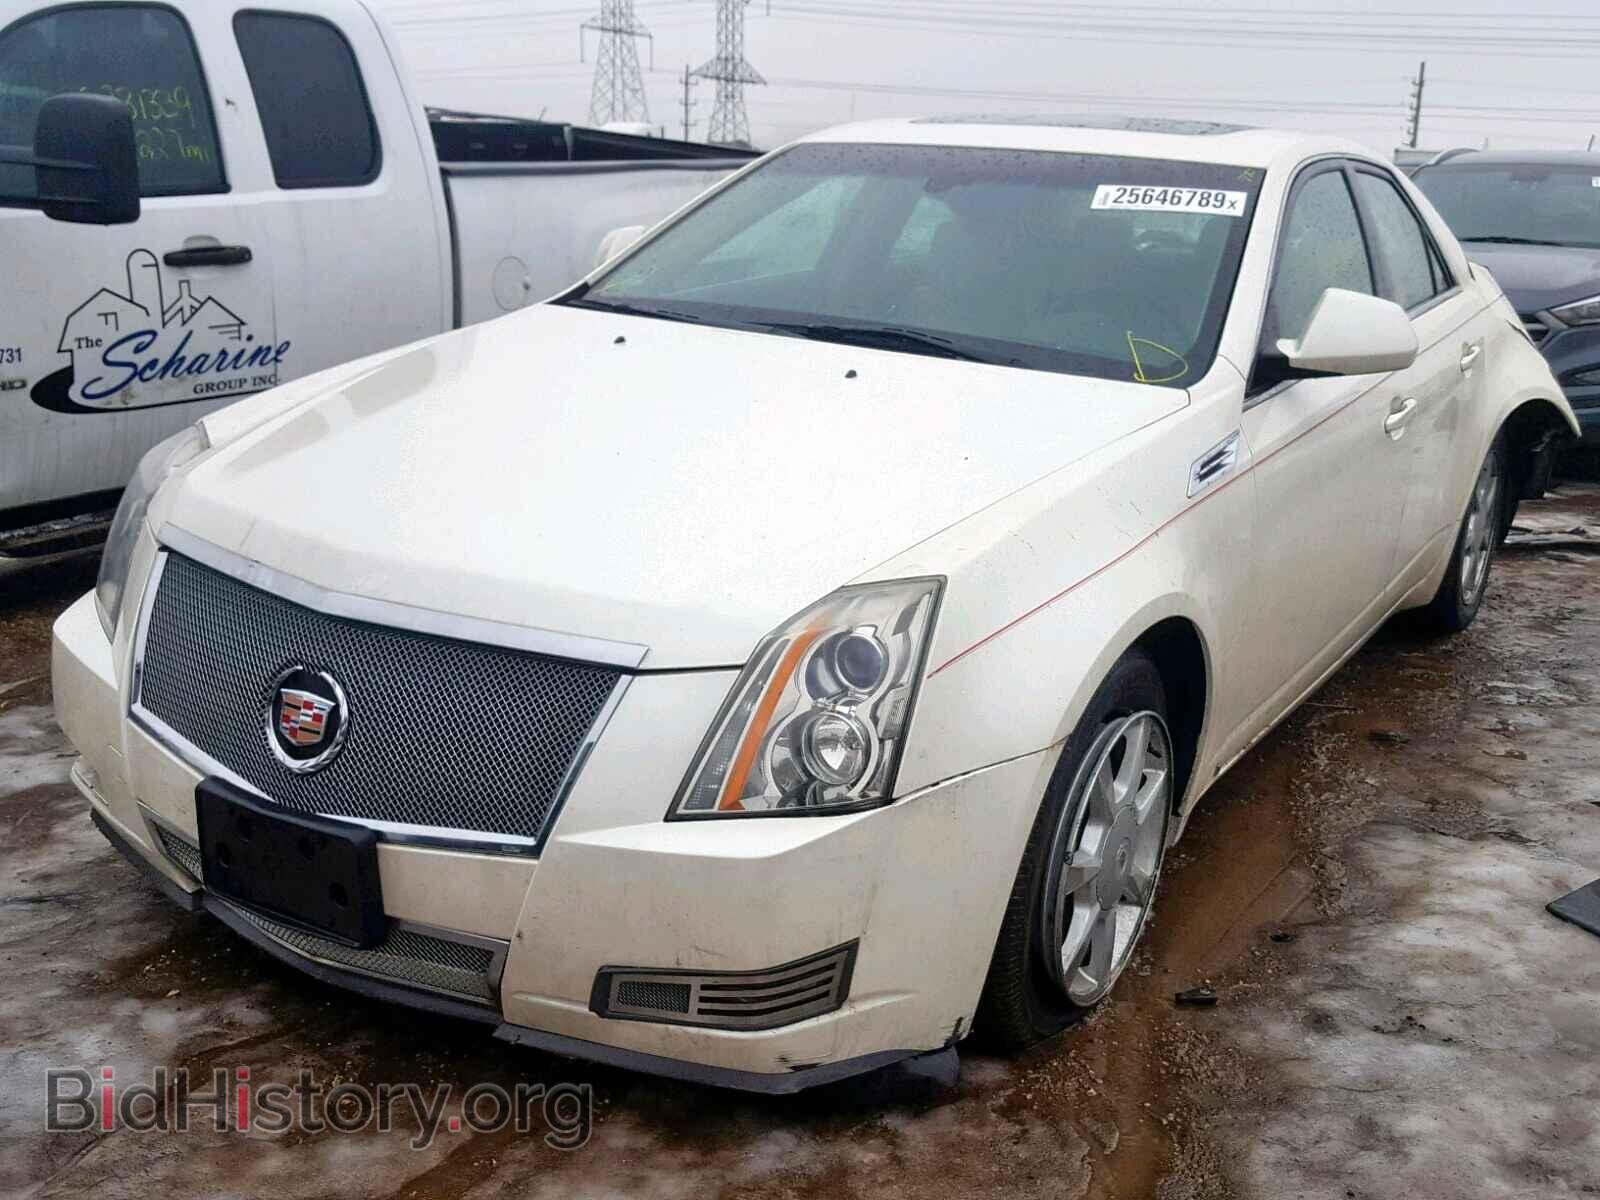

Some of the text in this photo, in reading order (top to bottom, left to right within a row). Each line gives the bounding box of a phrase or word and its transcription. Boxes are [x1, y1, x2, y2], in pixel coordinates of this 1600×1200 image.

[74, 337, 103, 350] The
[81, 329, 290, 400] Scharine
[193, 378, 248, 395] GROUP
